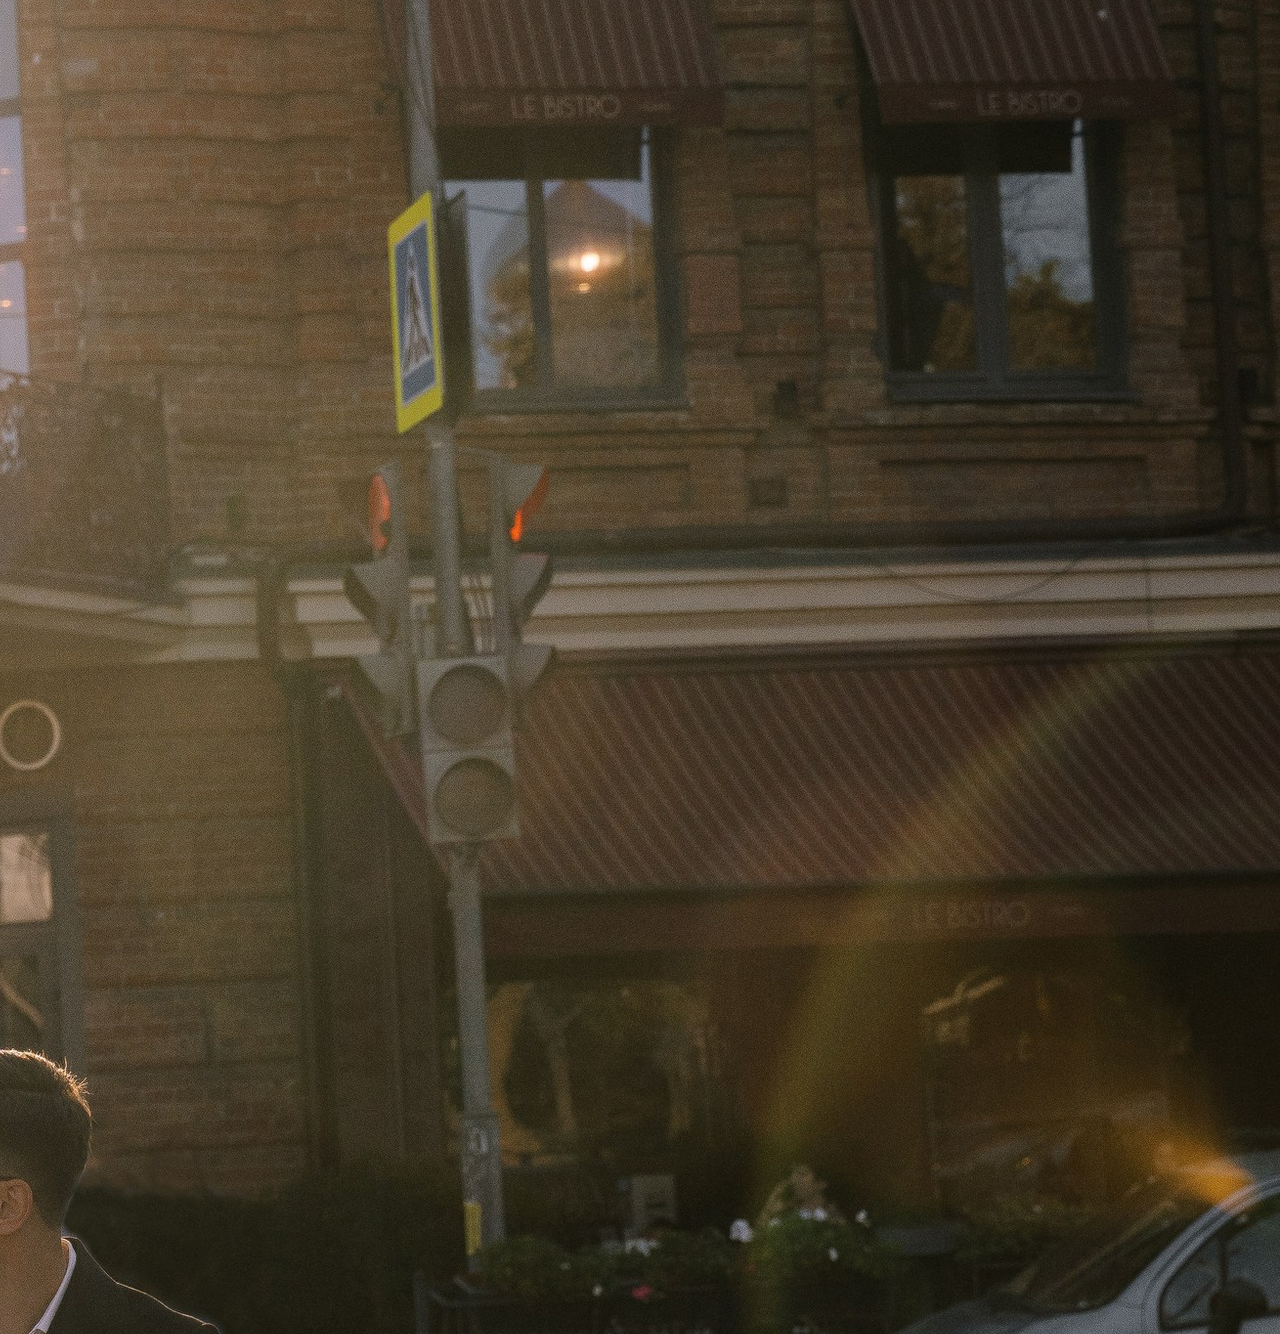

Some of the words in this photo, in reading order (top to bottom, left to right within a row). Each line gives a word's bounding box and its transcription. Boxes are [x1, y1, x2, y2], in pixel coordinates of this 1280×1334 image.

[509, 94, 538, 119] LE
[541, 93, 622, 119] BISTRO
[975, 91, 1002, 116] LE
[1006, 89, 1084, 116] BISTRO
[912, 902, 939, 929] LE
